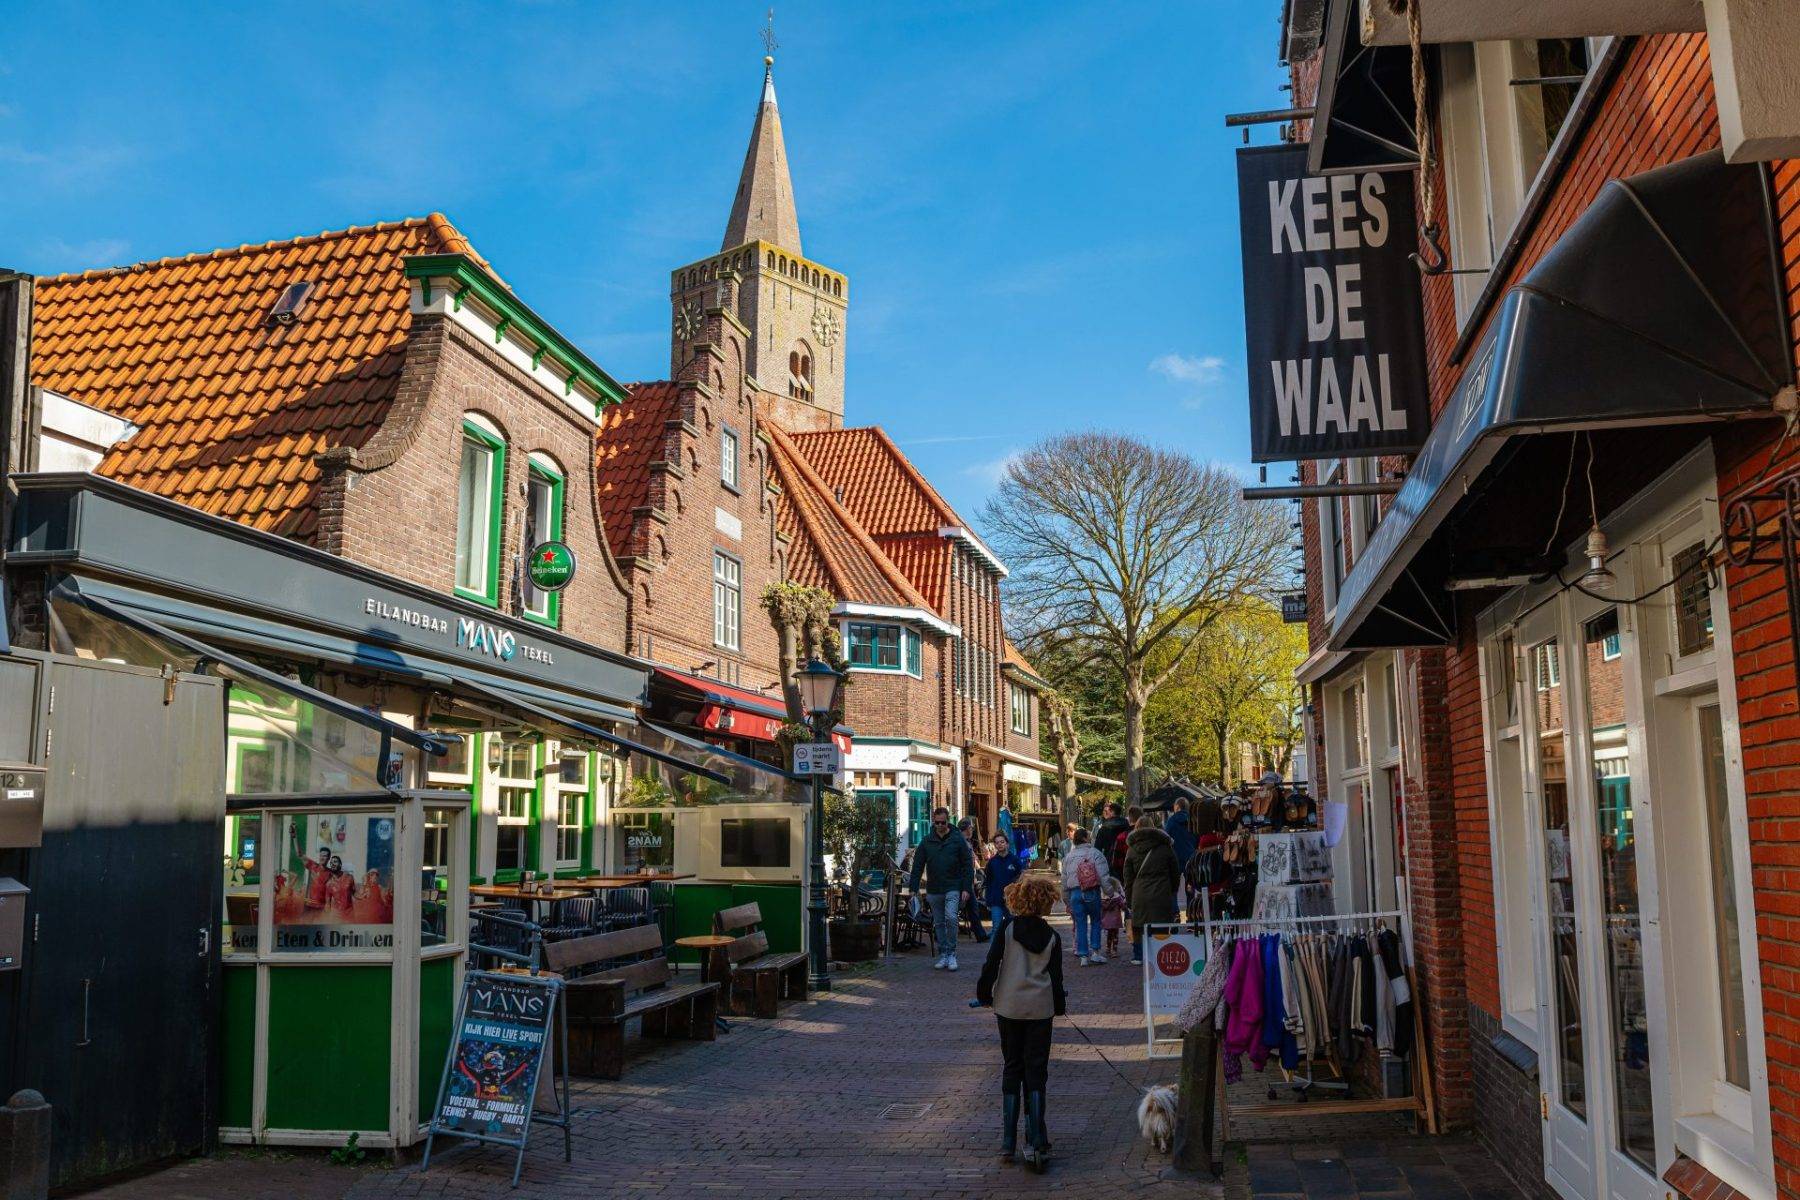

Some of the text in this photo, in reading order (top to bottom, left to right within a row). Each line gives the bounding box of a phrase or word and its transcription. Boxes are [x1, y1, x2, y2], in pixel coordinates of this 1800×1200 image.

[1269, 172, 1389, 254] KEES
[1304, 263, 1366, 342] DE
[1271, 353, 1408, 437] WAAL
[366, 599, 555, 665] EILANDBAR MANS TEXEL
[1, 773, 15, 788] 12
[276, 930, 308, 948] Eten
[313, 930, 325, 948] &
[473, 989, 544, 1015] MANS
[464, 1023, 544, 1043] KIJK HIER LIVE SPORT
[442, 1105, 467, 1119] TENNIS
[472, 1110, 497, 1122] RUGBY
[501, 1114, 526, 1126] DARTS
[449, 1095, 480, 1109] VOETBAL
[486, 1100, 519, 1114] FORMULE
[519, 1104, 526, 1115] 1
